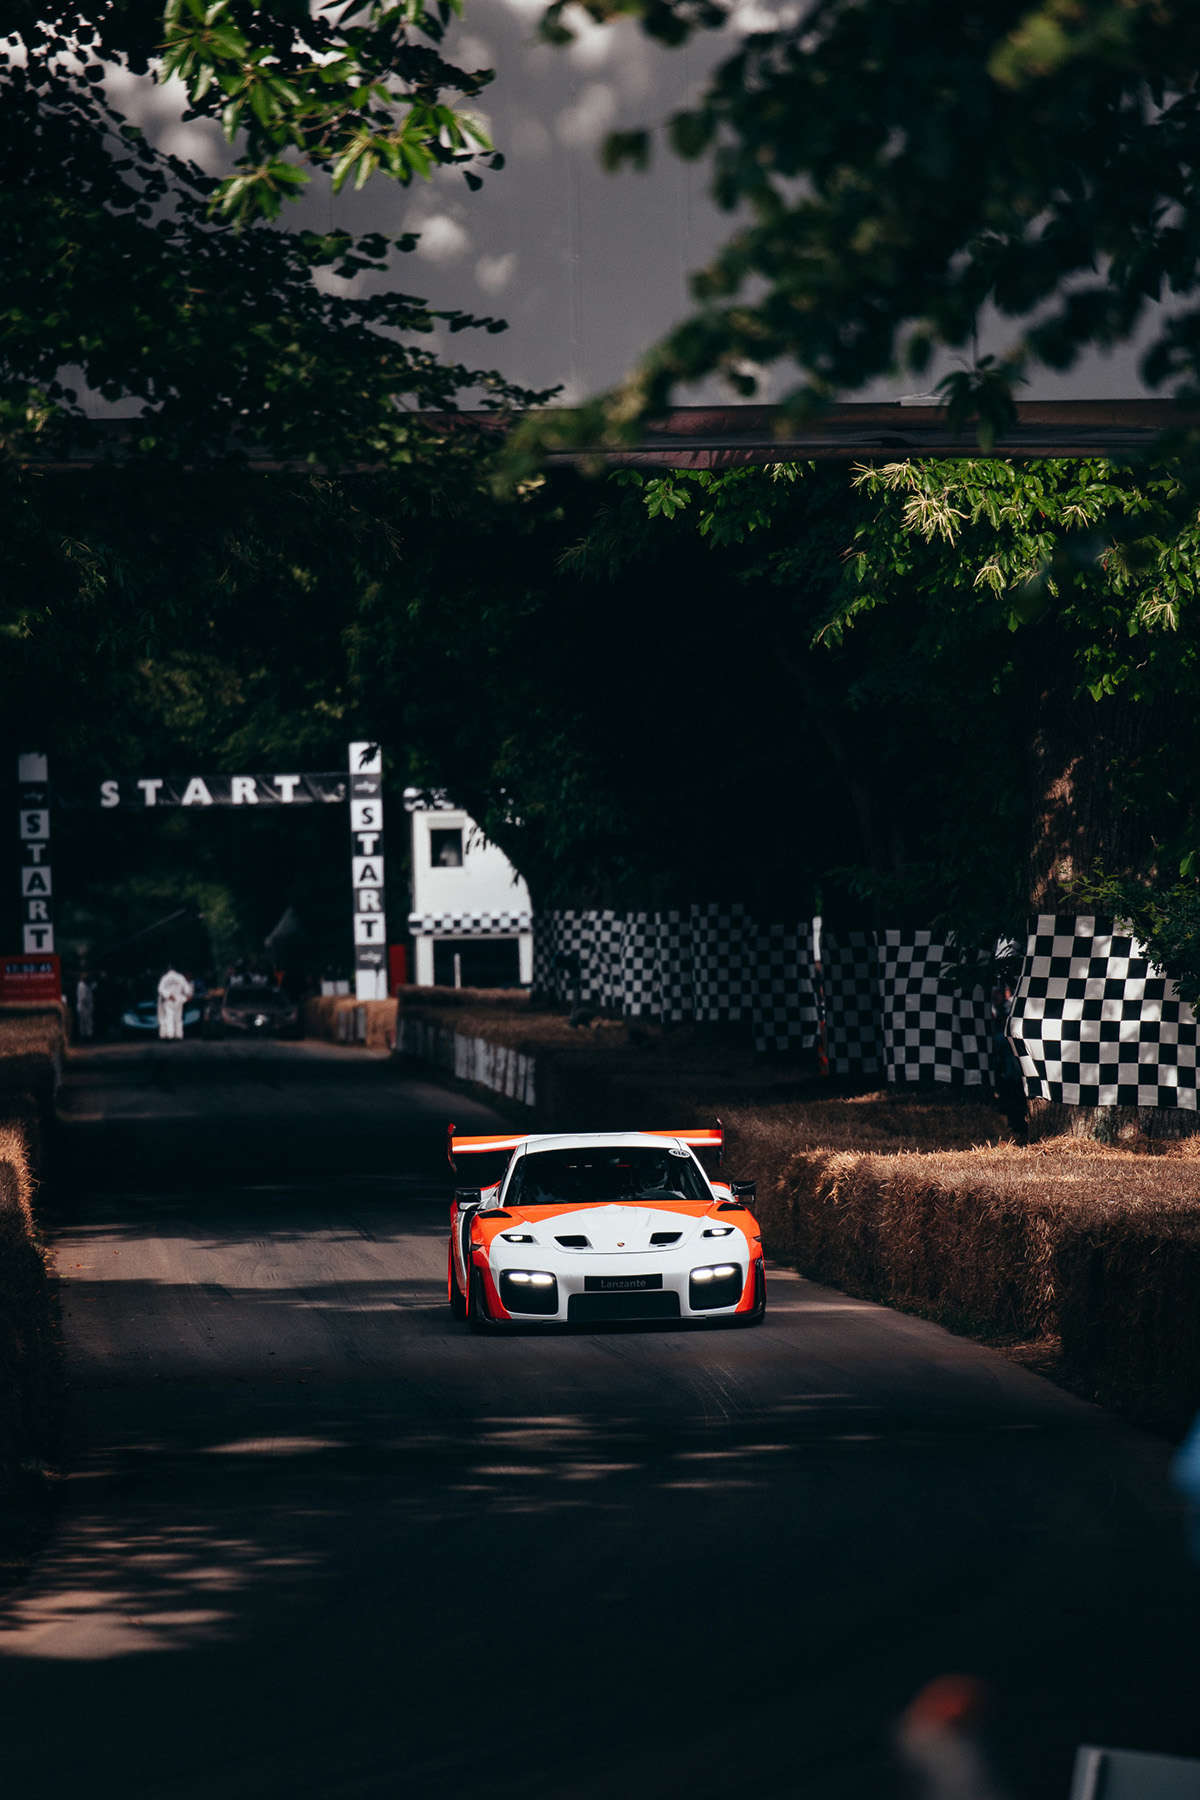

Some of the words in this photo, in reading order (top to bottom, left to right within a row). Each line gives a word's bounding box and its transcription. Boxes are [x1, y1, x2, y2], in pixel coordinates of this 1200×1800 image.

[101, 775, 300, 808] START
[26, 813, 49, 949] START
[357, 807, 381, 938] START
[601, 1279, 646, 1288] Lanzante
